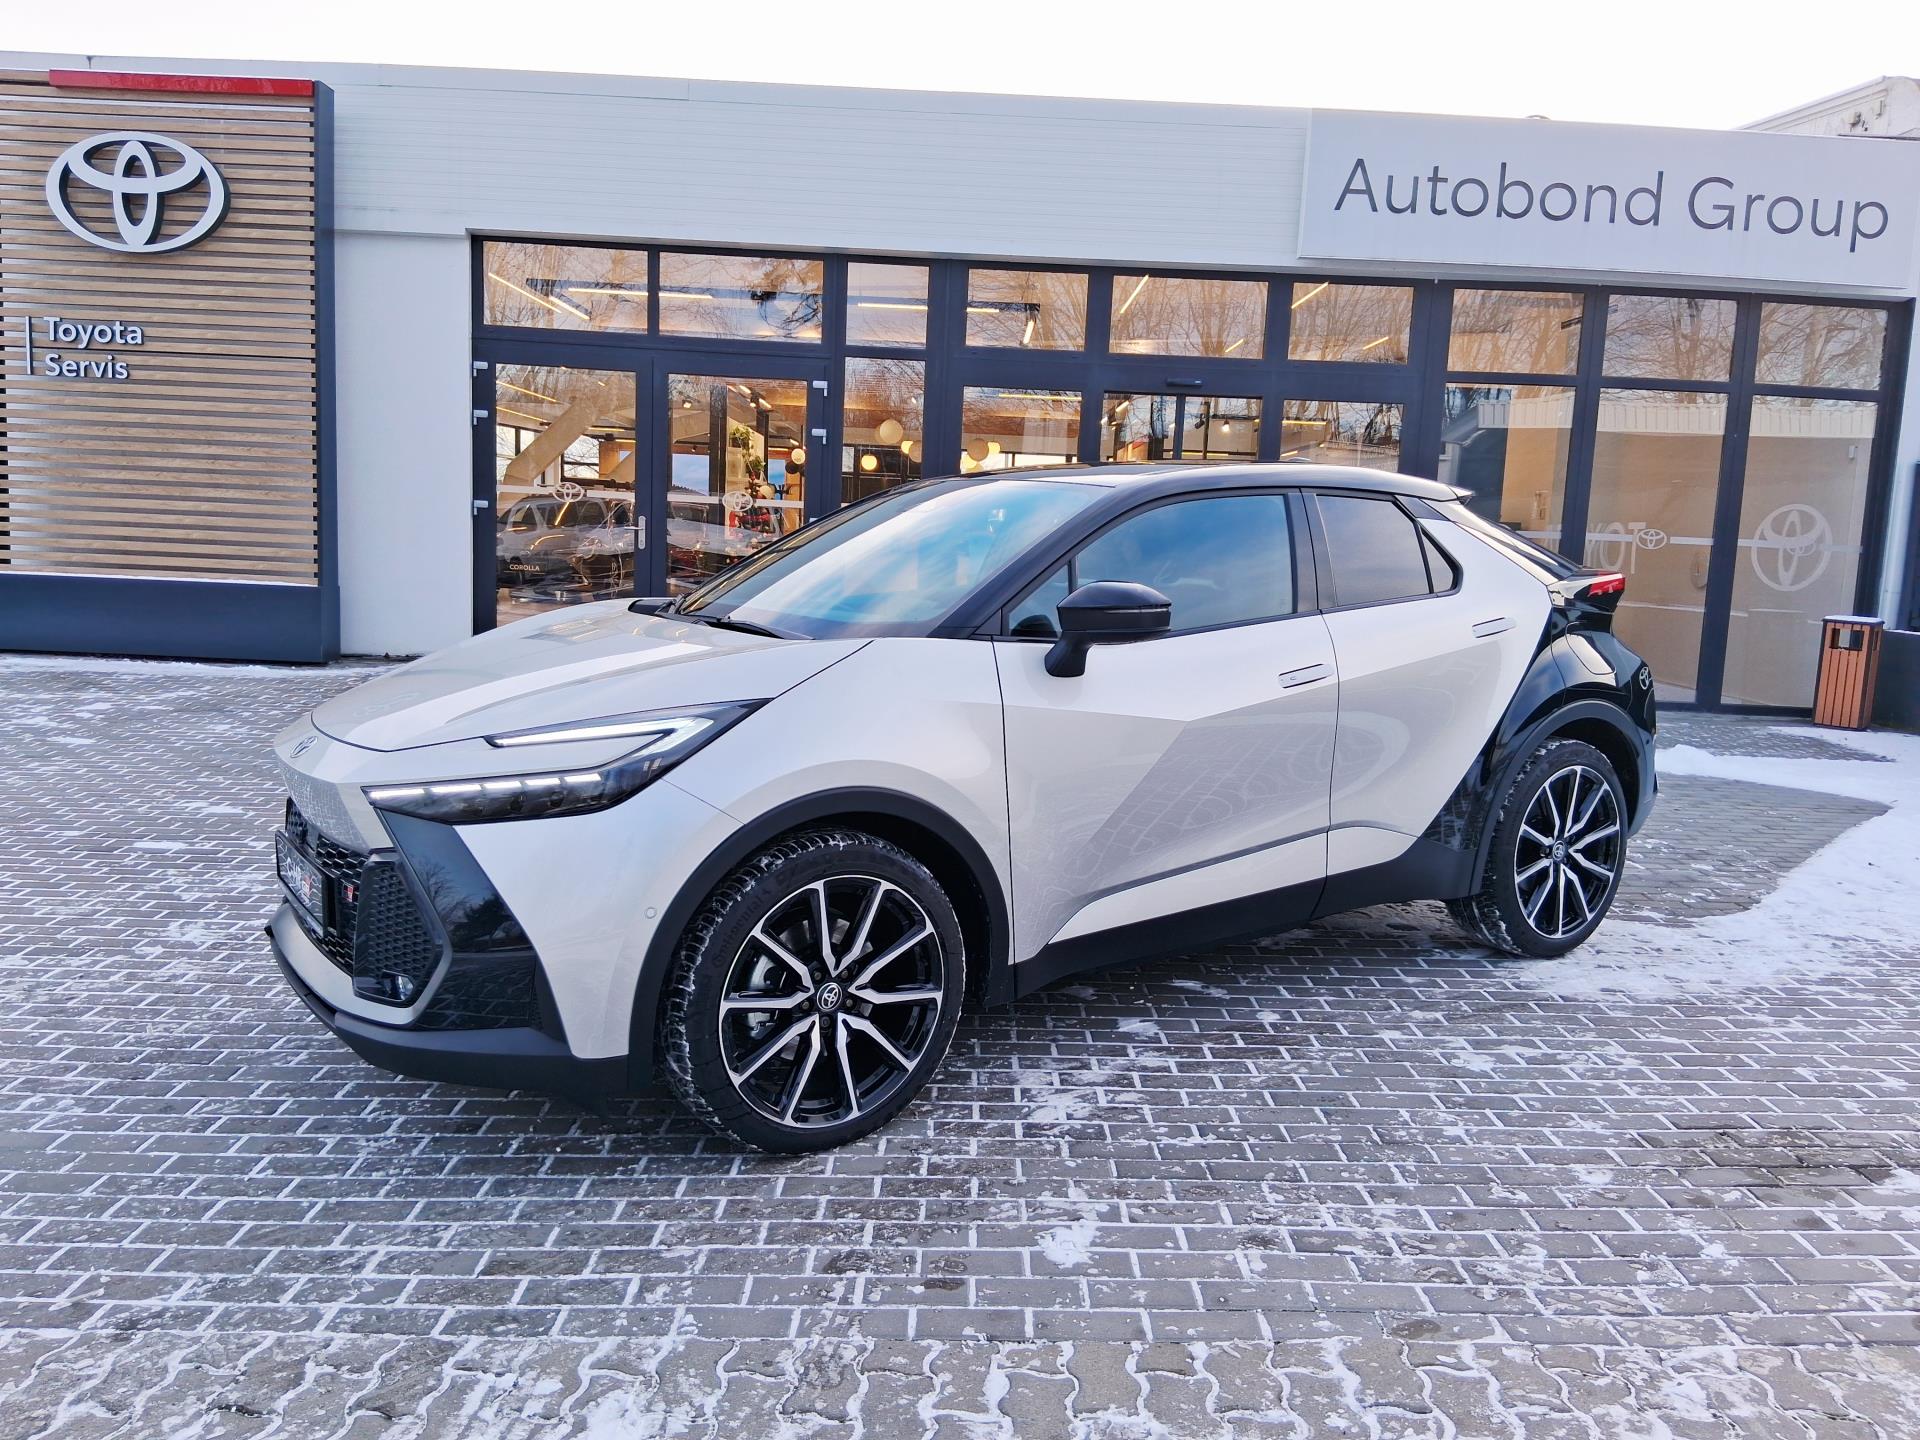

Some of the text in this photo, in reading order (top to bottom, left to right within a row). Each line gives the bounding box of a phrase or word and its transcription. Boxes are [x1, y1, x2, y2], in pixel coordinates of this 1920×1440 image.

[1334, 158, 1889, 253] Autobond Group
[43, 316, 144, 348] Toyota
[45, 353, 129, 380] Servis
